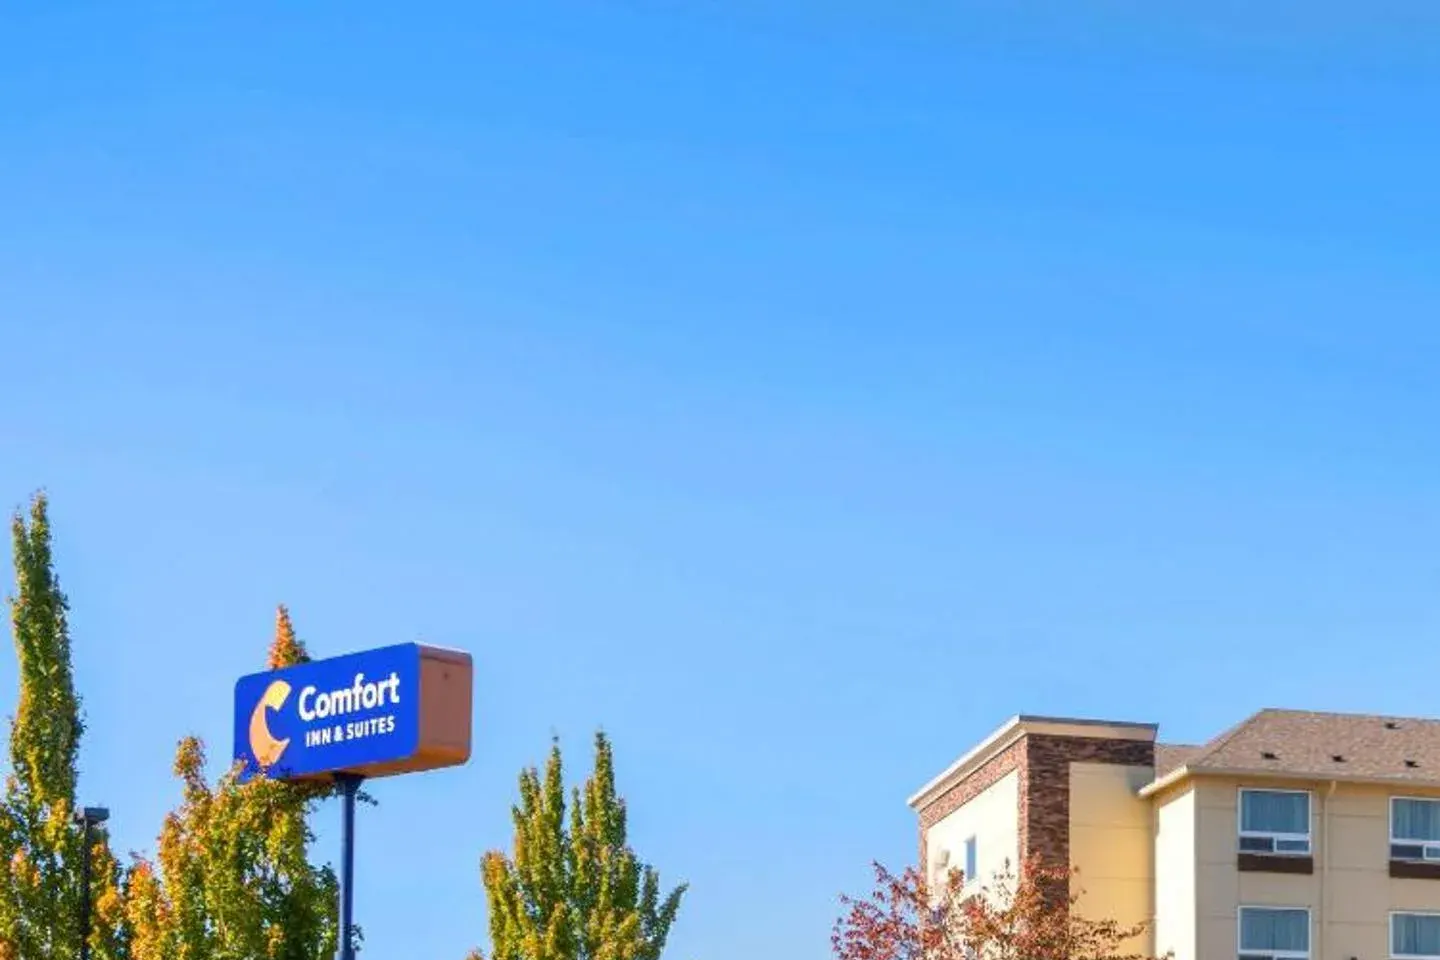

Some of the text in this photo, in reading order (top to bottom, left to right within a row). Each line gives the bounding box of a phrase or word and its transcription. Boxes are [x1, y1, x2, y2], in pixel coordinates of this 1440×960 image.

[298, 672, 400, 721] Comfort
[306, 715, 395, 748] INN & SUITES
